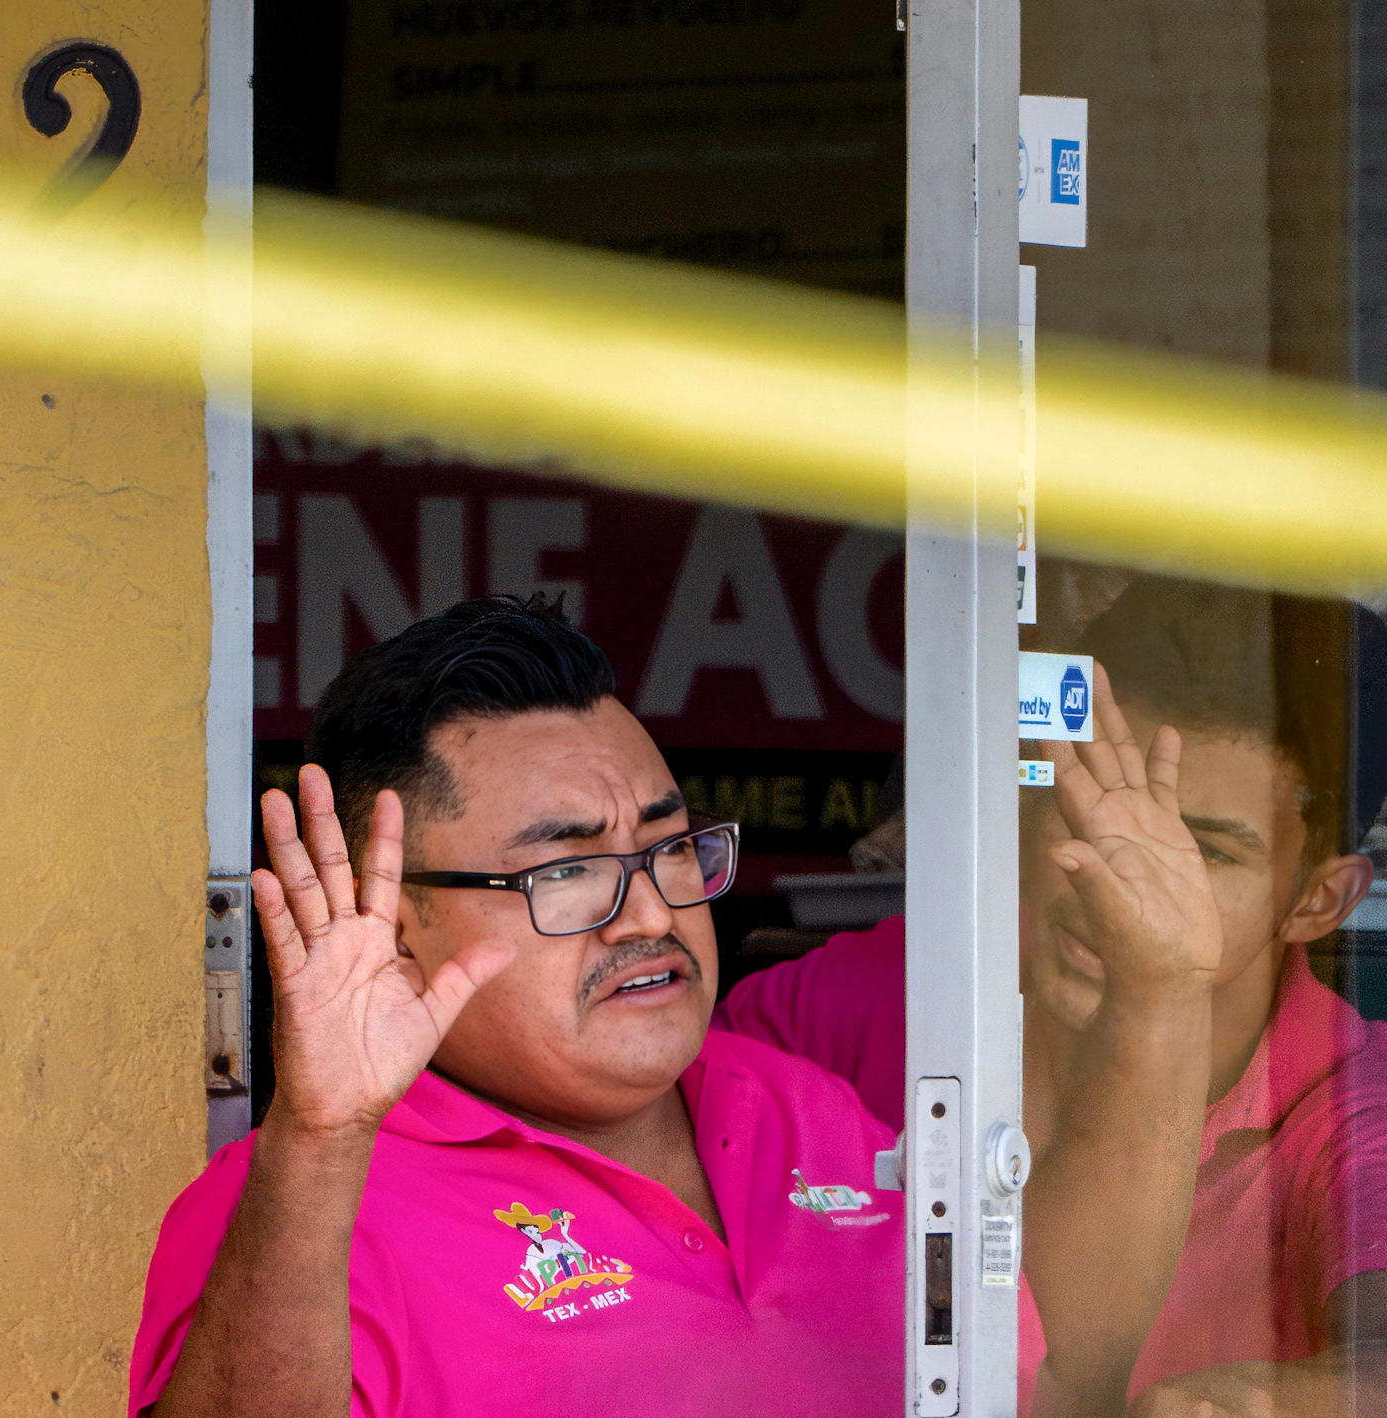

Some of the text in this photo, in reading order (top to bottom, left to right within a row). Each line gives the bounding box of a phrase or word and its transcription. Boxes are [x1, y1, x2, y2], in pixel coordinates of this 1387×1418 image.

[1019, 688, 1085, 718] red by ADT
[543, 1287, 631, 1323] TEX MEX
